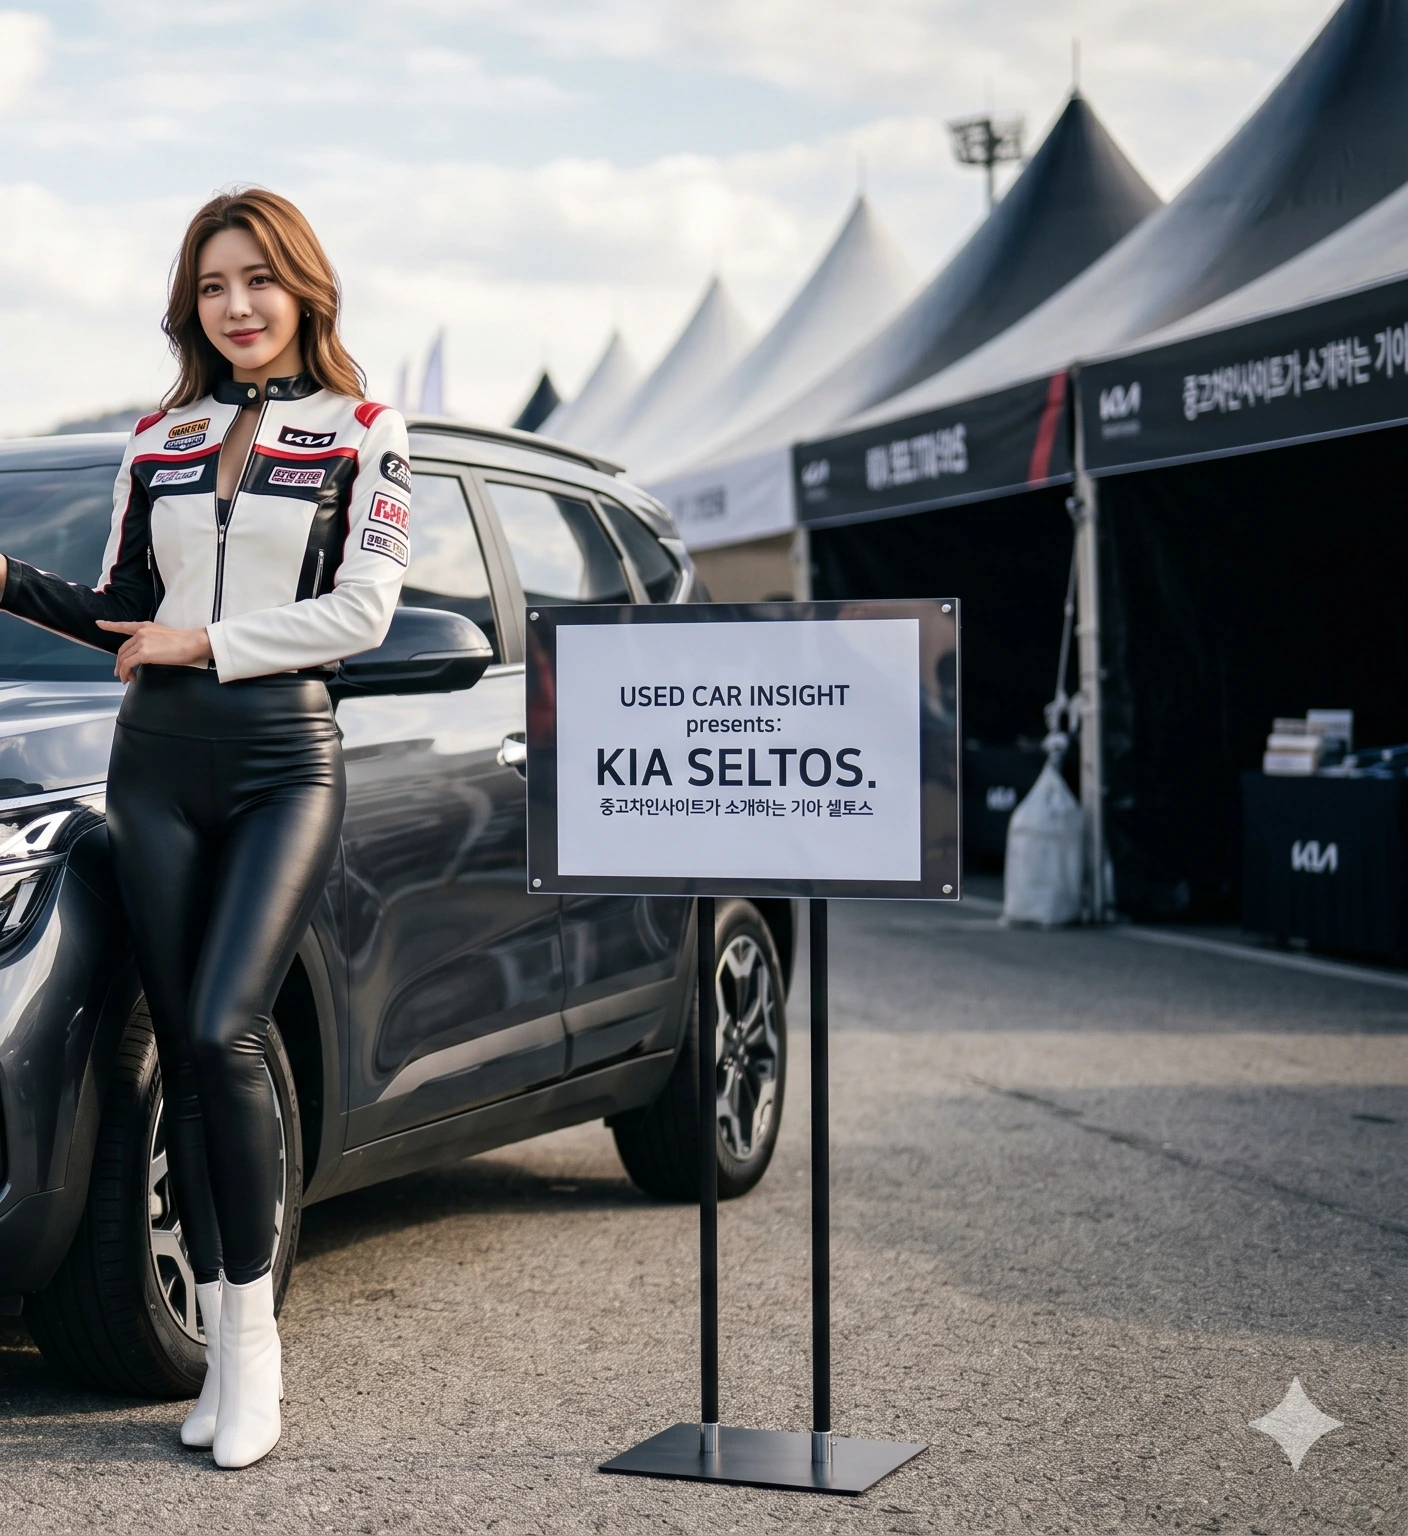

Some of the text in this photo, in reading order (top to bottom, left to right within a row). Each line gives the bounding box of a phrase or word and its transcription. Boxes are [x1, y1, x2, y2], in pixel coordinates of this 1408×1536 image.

[285, 433, 332, 445] KIA
[620, 684, 850, 708] USED CAR INSIGHT
[686, 715, 782, 738] presents:
[597, 747, 877, 789] KIA SELTOS.
[599, 797, 874, 818] 중고차인사이트가 소개하는 기아 셀토스
